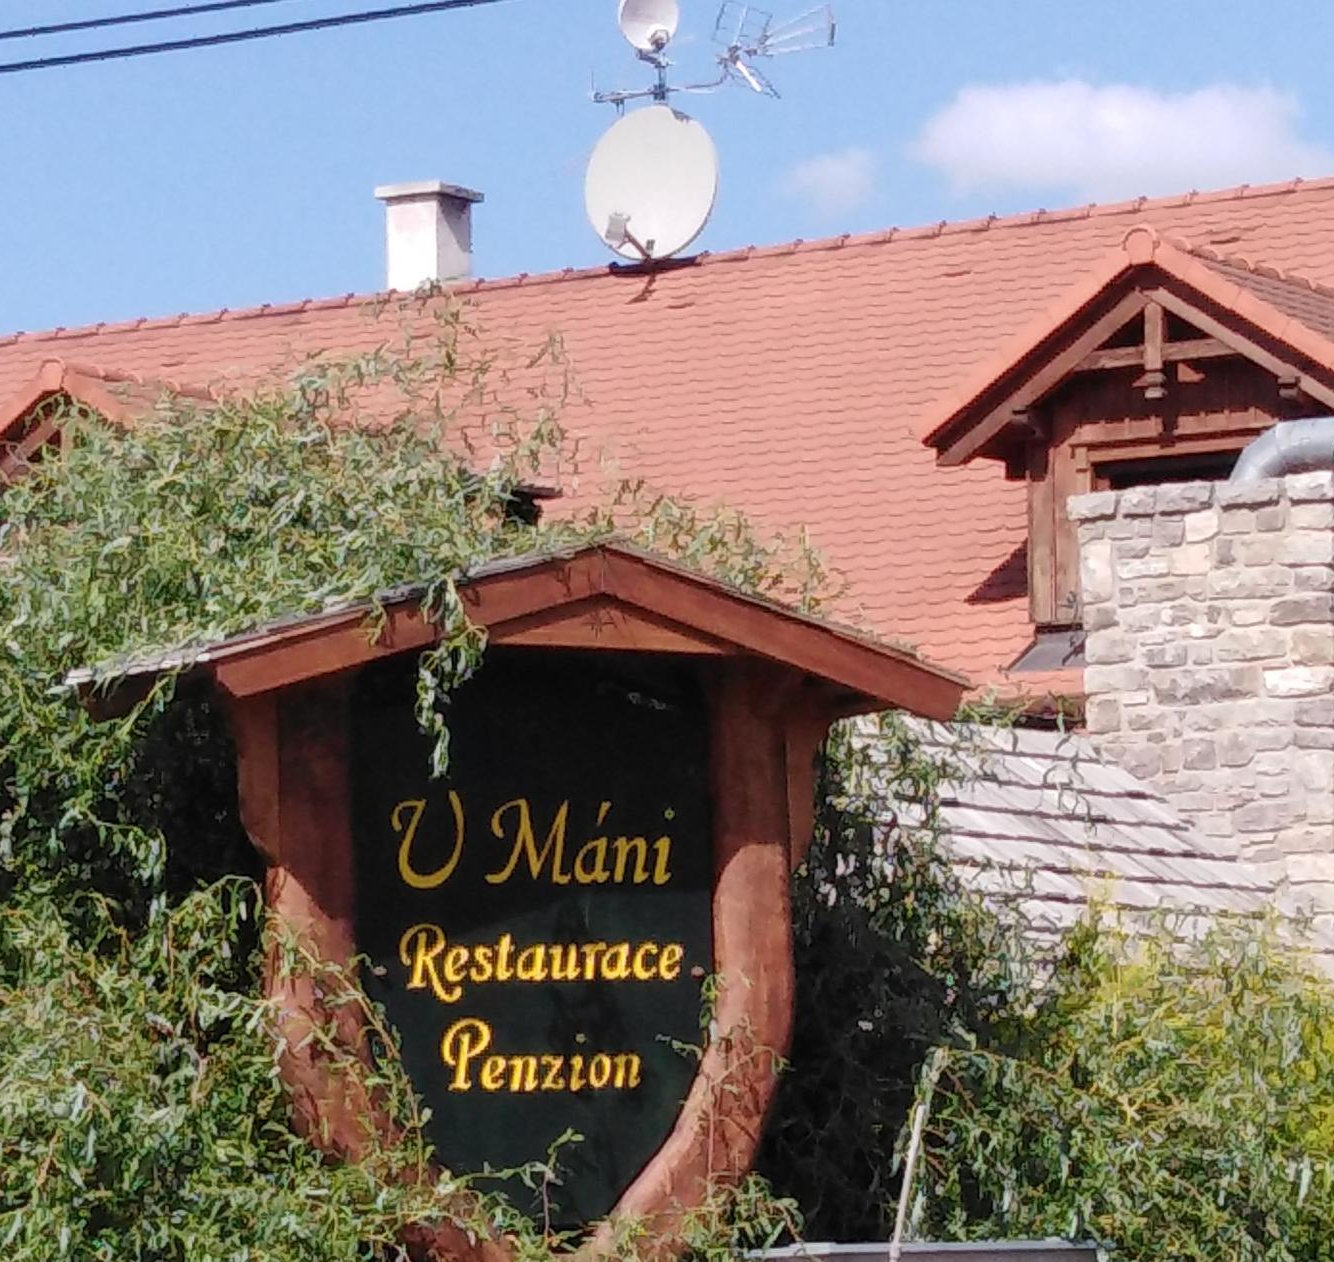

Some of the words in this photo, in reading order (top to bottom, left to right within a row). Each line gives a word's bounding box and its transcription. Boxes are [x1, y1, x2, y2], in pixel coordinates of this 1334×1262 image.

[391, 790, 464, 889] U
[485, 799, 675, 886] Máni
[398, 923, 684, 1002] Restaurace
[440, 1018, 643, 1092] Penzion
